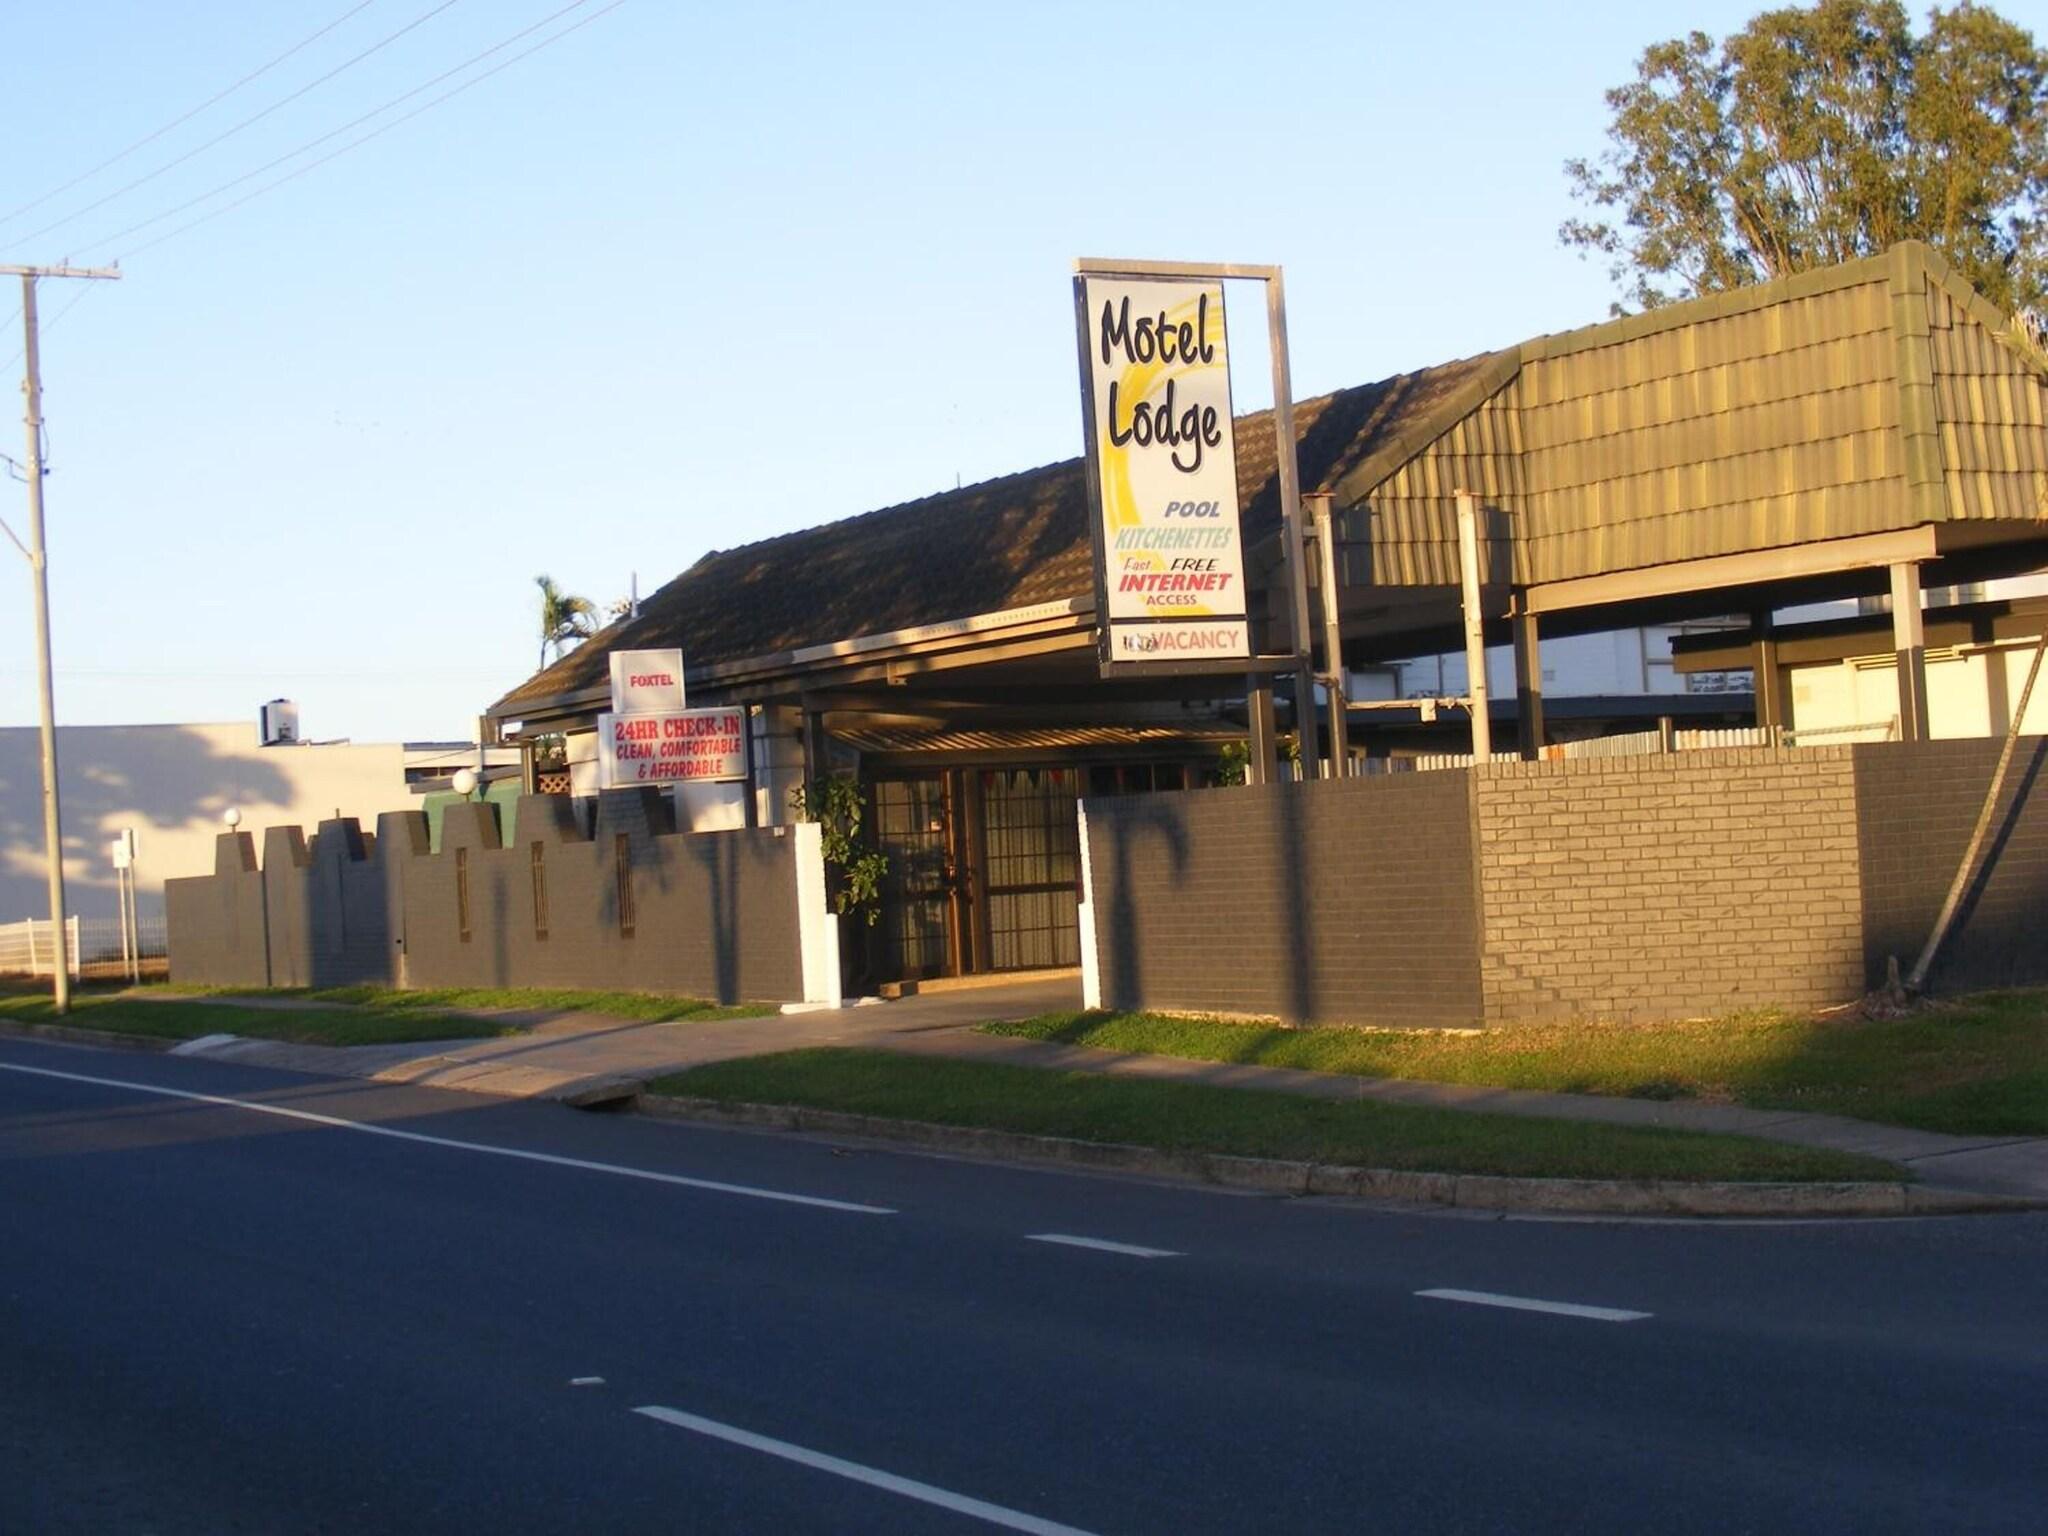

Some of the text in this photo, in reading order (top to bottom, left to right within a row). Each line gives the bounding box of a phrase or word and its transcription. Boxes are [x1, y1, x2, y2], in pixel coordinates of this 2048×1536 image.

[1101, 293, 1213, 364] Motel
[1109, 378, 1221, 473] Lodge
[1164, 501, 1220, 518] POOL
[1115, 526, 1233, 550] KITCHENETTES
[1123, 557, 1220, 572] Fast FREE
[1118, 573, 1233, 592] INTERNET
[1146, 595, 1197, 606] ACCESS
[1154, 630, 1239, 650] VACANCY
[630, 674, 674, 687] FOXTEL
[615, 715, 740, 741] 24HR CHECK-IN
[616, 738, 741, 760] CLEAN, COMFORTABLE
[638, 760, 723, 779] & AFFORDABLE
